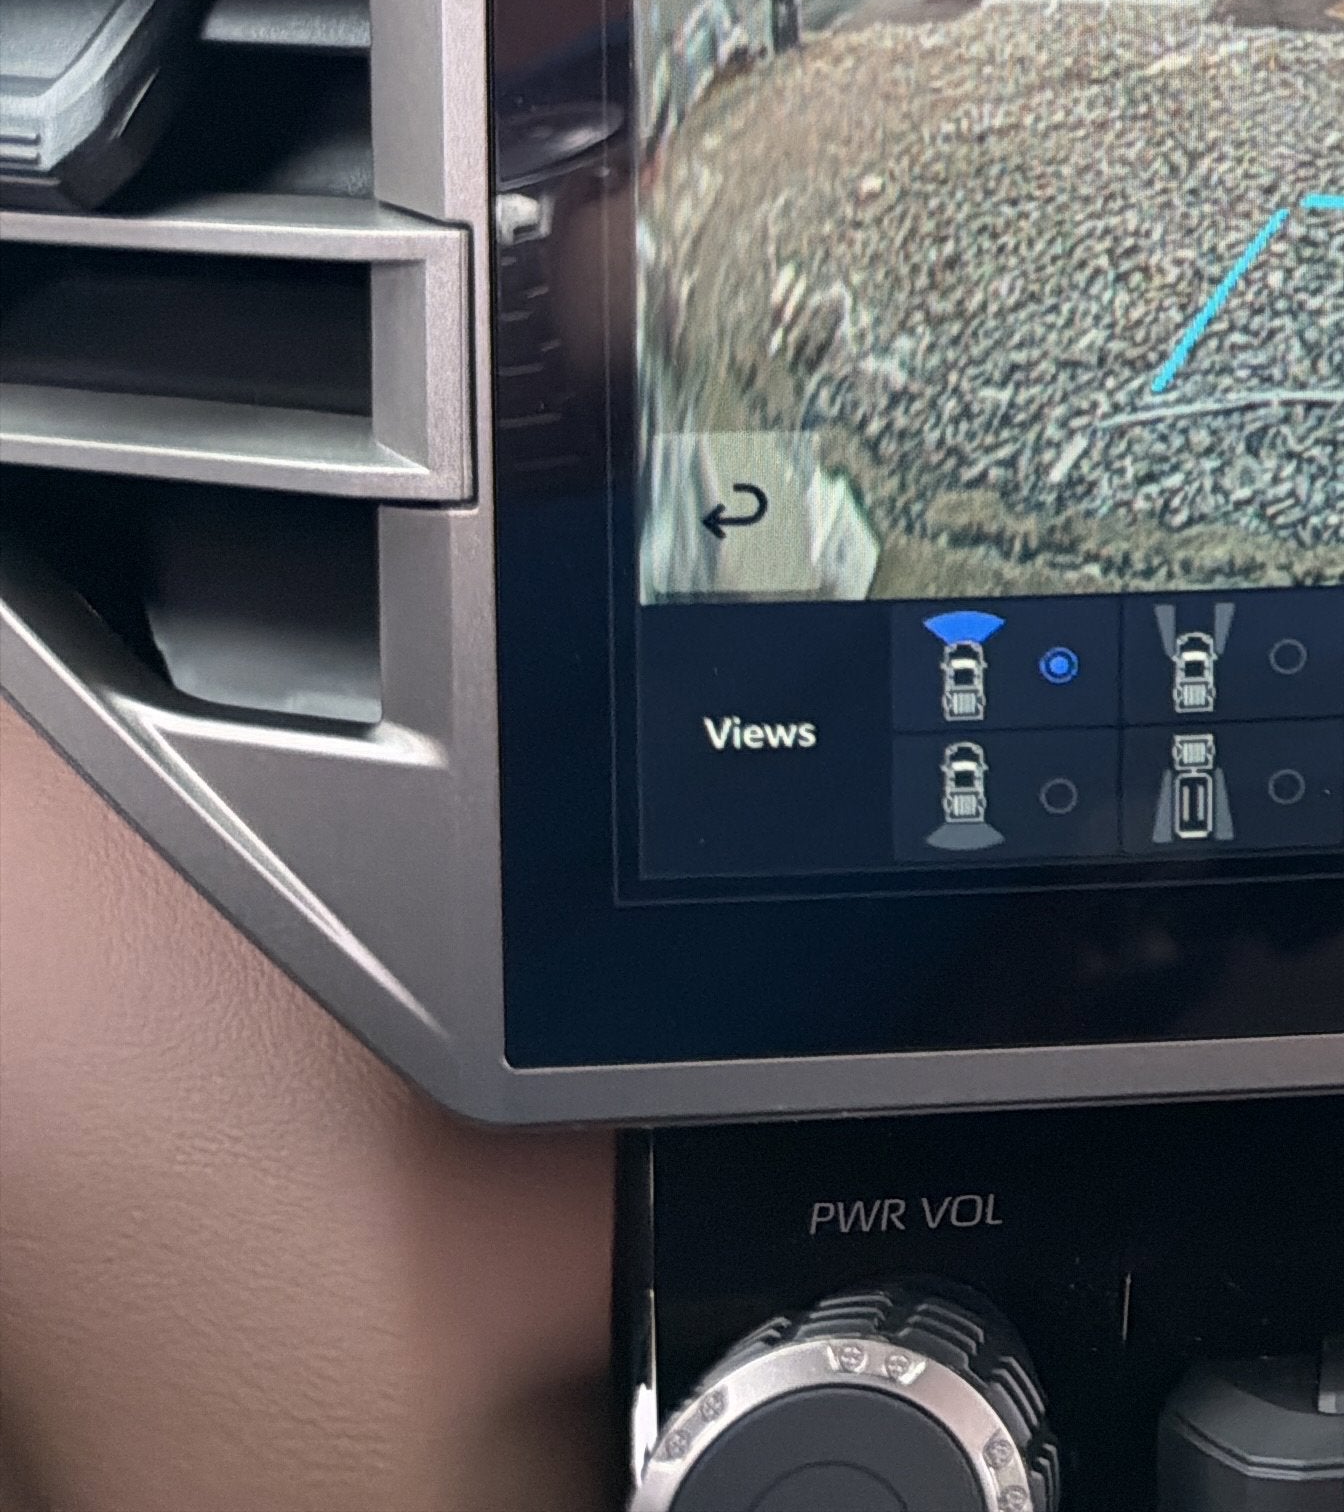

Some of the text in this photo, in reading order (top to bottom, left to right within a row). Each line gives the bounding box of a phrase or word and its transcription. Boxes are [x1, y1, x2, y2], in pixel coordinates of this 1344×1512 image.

[703, 715, 818, 751] Views
[809, 1192, 1006, 1236] PWR VOL
